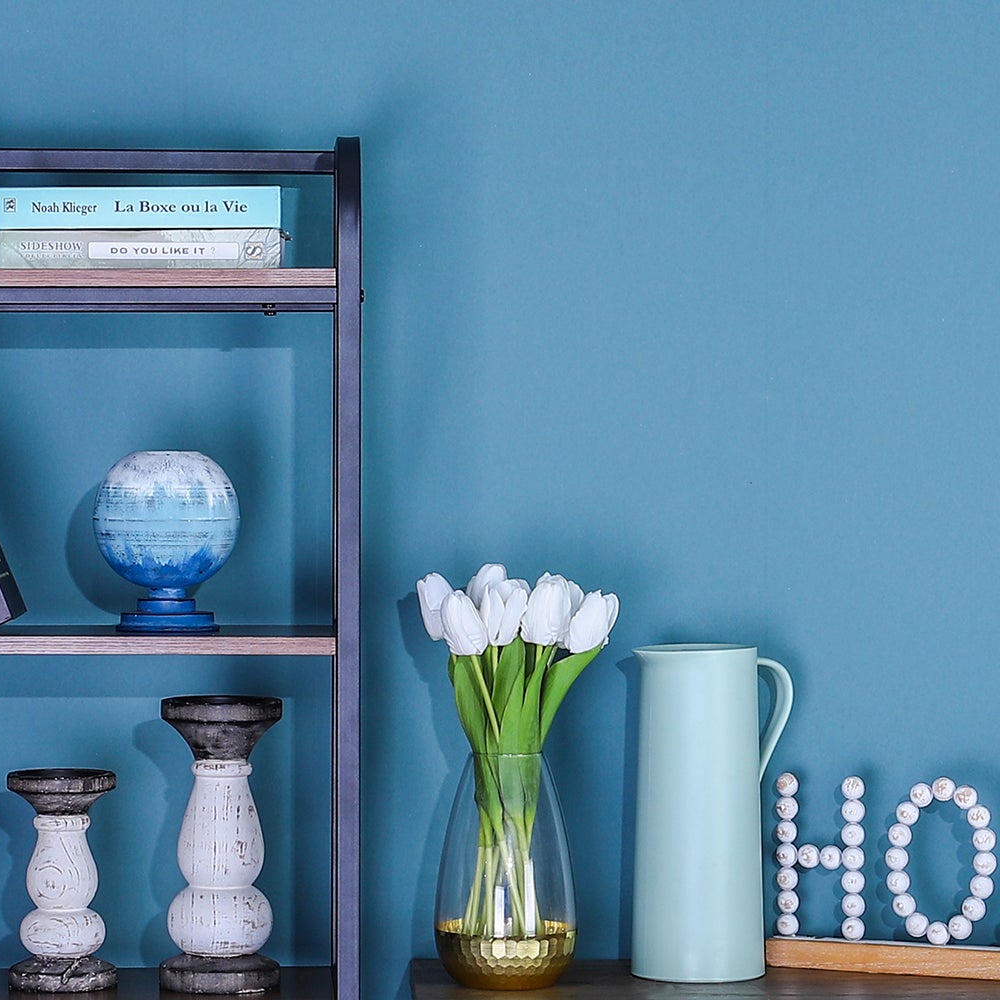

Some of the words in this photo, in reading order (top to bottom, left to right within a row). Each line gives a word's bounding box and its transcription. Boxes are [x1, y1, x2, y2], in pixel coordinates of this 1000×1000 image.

[31, 201, 60, 213] Noah
[61, 201, 98, 216] Klieger
[114, 200, 134, 213] La
[138, 200, 177, 213] Boxe
[181, 203, 200, 213] ou
[204, 201, 218, 213] la
[222, 200, 248, 213] Vie
[20, 240, 82, 251] SIDESHOW
[110, 246, 128, 255] DO
[132, 246, 158, 255] YOU
[161, 246, 189, 255] LIKE
